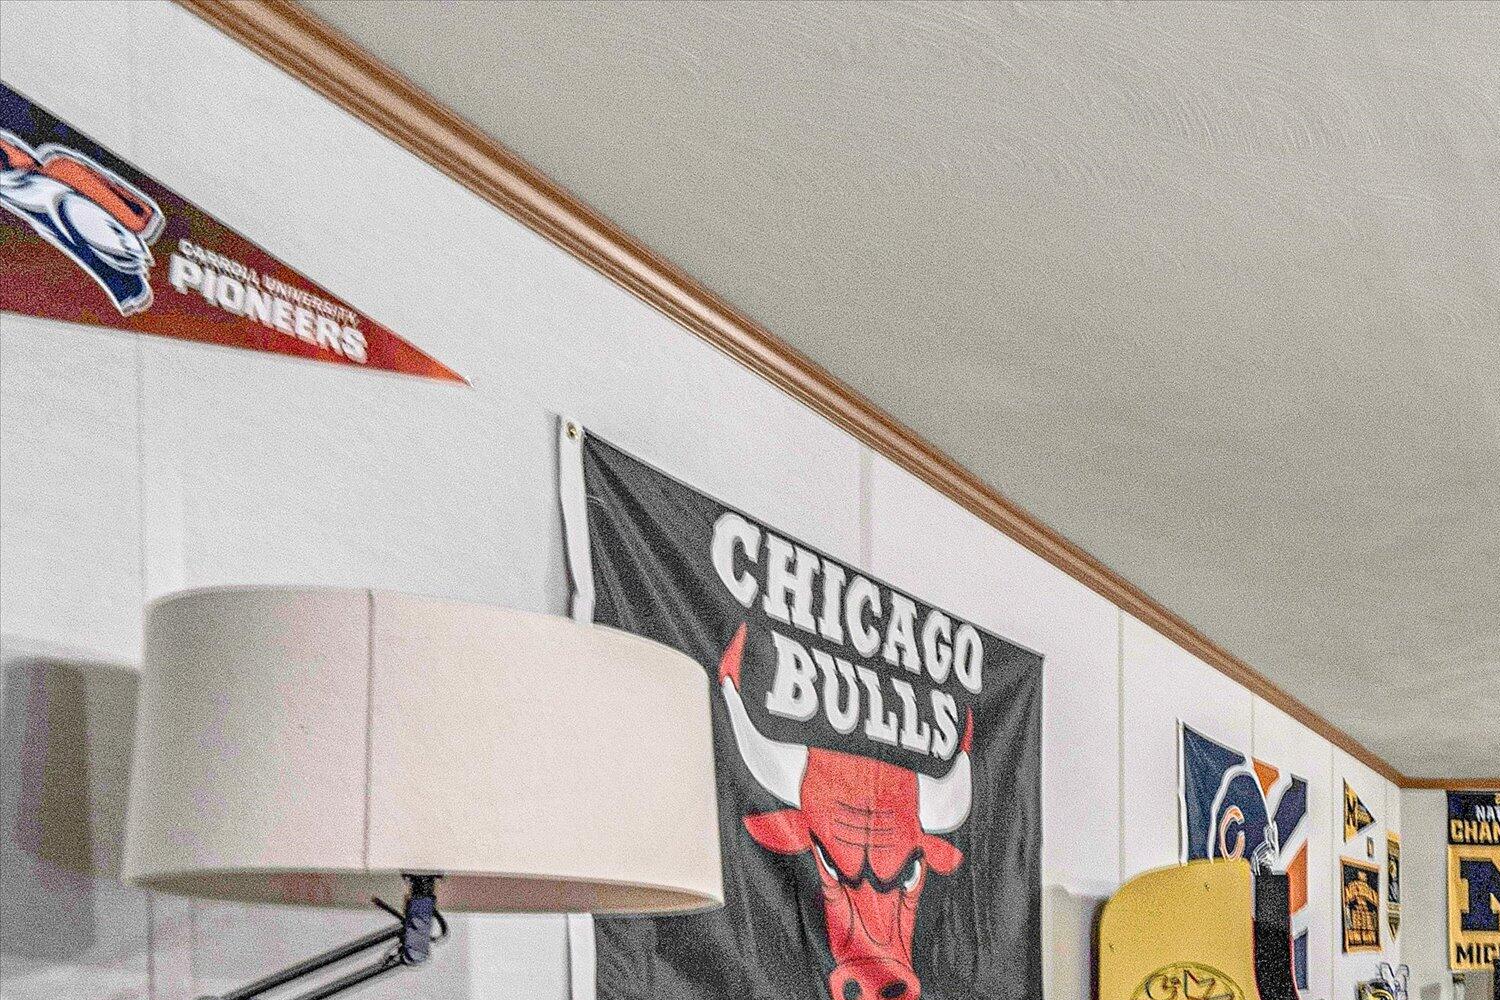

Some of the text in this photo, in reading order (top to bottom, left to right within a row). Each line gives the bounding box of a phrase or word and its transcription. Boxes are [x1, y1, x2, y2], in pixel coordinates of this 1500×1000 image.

[170, 255, 367, 364] PIONEERS
[262, 275, 360, 328] UNIVERSITY
[712, 513, 983, 693] CHICAGO
[766, 630, 959, 760] BULLS
